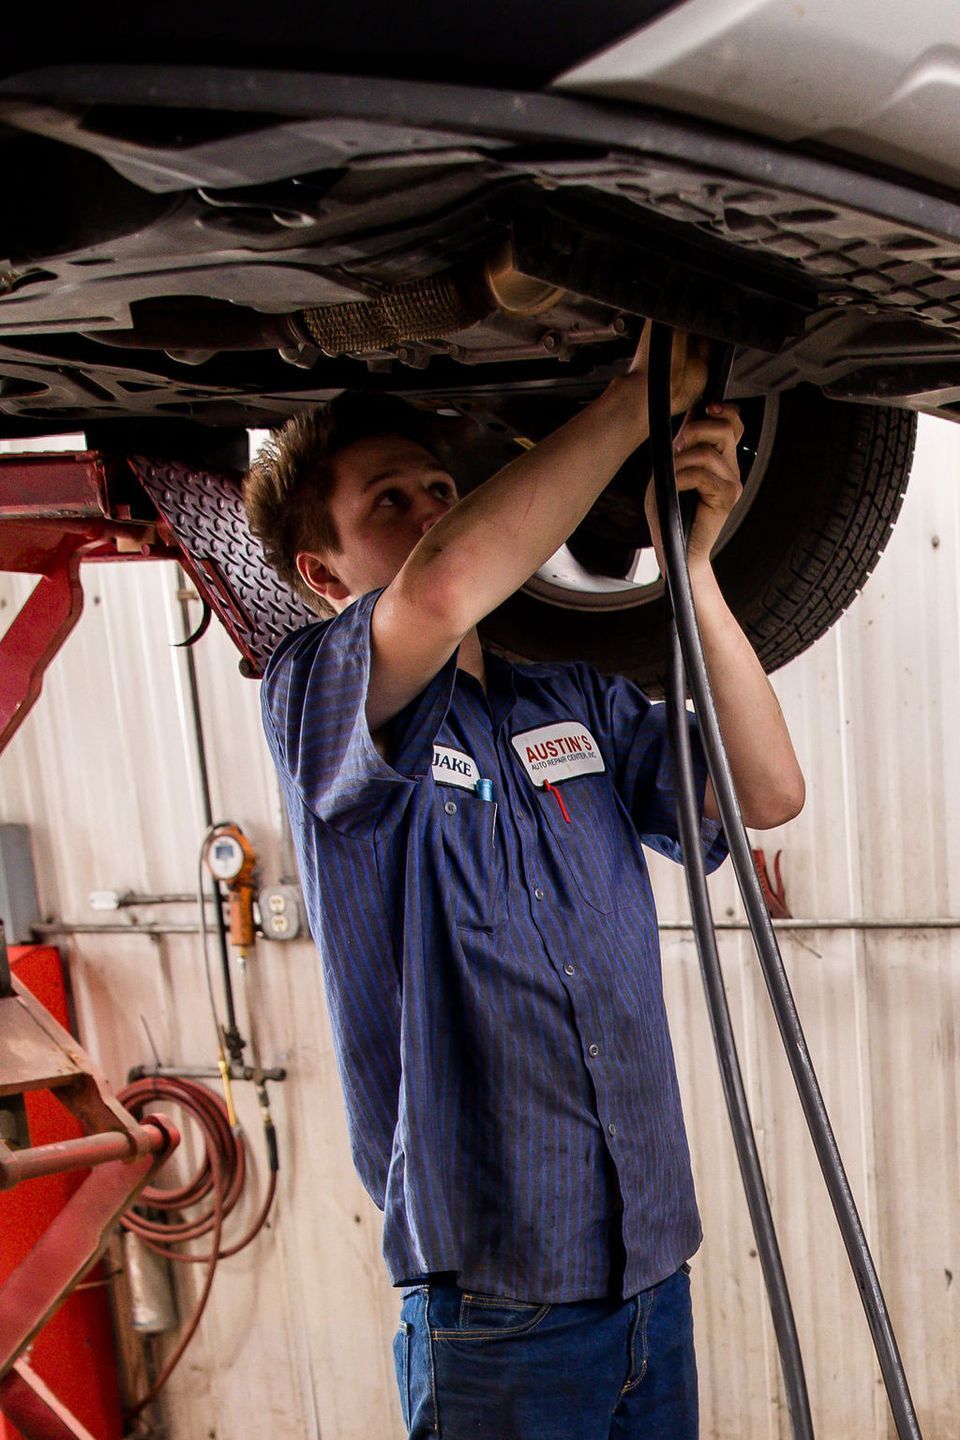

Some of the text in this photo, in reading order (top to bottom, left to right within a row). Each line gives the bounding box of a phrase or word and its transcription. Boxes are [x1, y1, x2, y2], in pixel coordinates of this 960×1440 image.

[525, 735, 592, 763] AUSTIN'S
[531, 761, 547, 771] AUTO
[547, 756, 568, 767] REPAIR
[567, 753, 589, 762] CENTER,
[432, 752, 472, 778] JAKE
